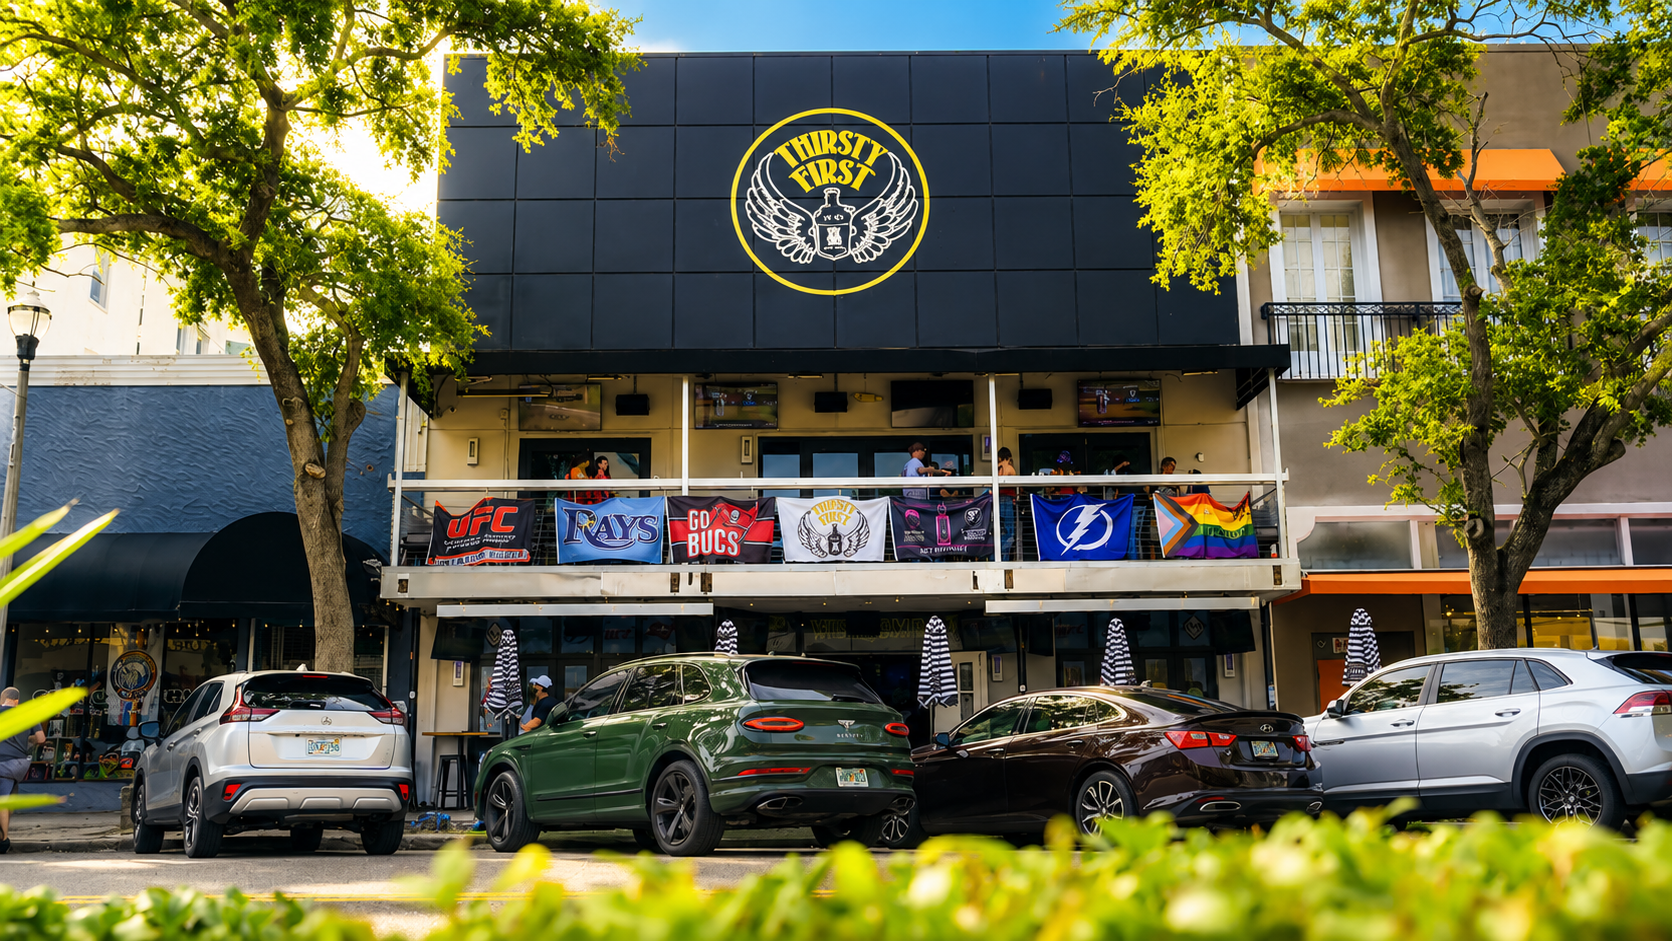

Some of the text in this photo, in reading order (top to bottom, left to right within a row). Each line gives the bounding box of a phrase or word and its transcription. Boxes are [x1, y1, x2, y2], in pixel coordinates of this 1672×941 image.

[774, 130, 889, 168] THIRSTY
[788, 158, 876, 193] FIRST
[447, 506, 518, 538] UFC
[562, 507, 659, 550] RAYS
[689, 510, 710, 531] GO
[688, 529, 739, 557] BUCS
